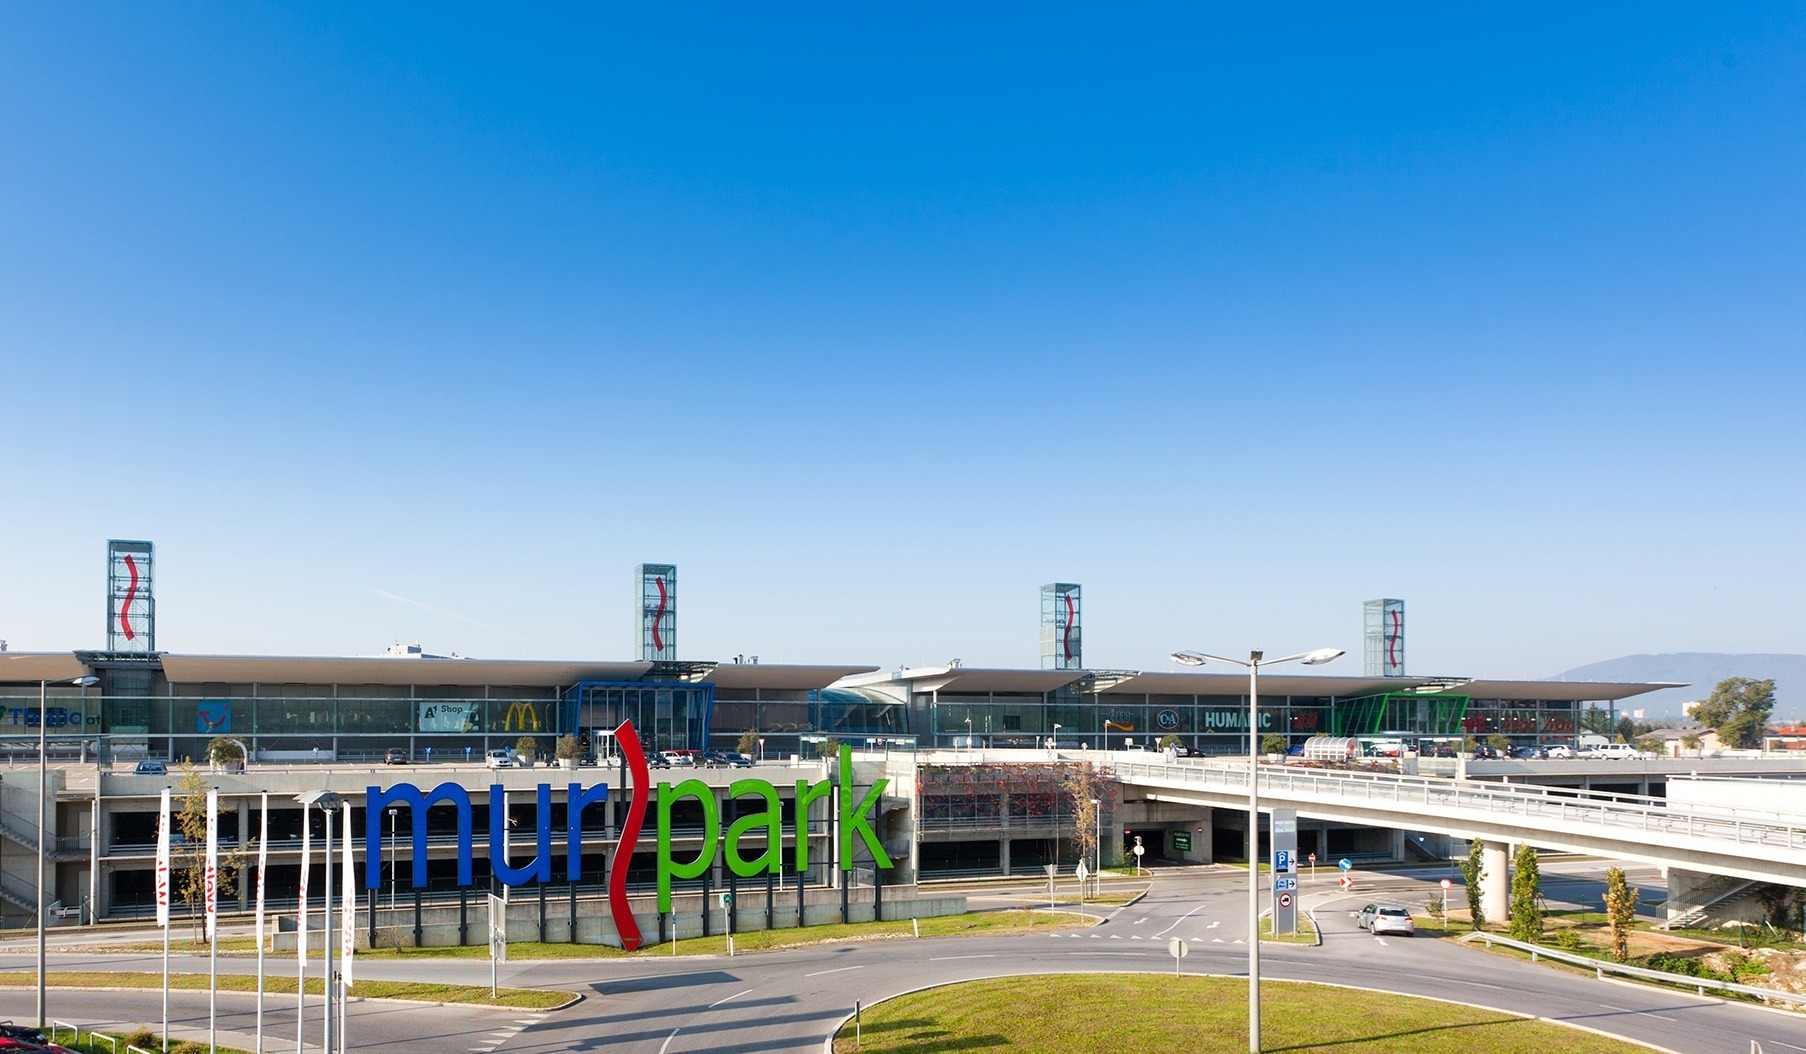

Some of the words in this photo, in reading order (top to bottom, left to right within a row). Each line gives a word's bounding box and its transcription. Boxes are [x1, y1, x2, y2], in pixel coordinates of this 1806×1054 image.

[440, 705, 463, 714] Shop
[1205, 712, 1272, 728] HUMAIC
[366, 782, 608, 890] mur
[657, 745, 895, 914] park
